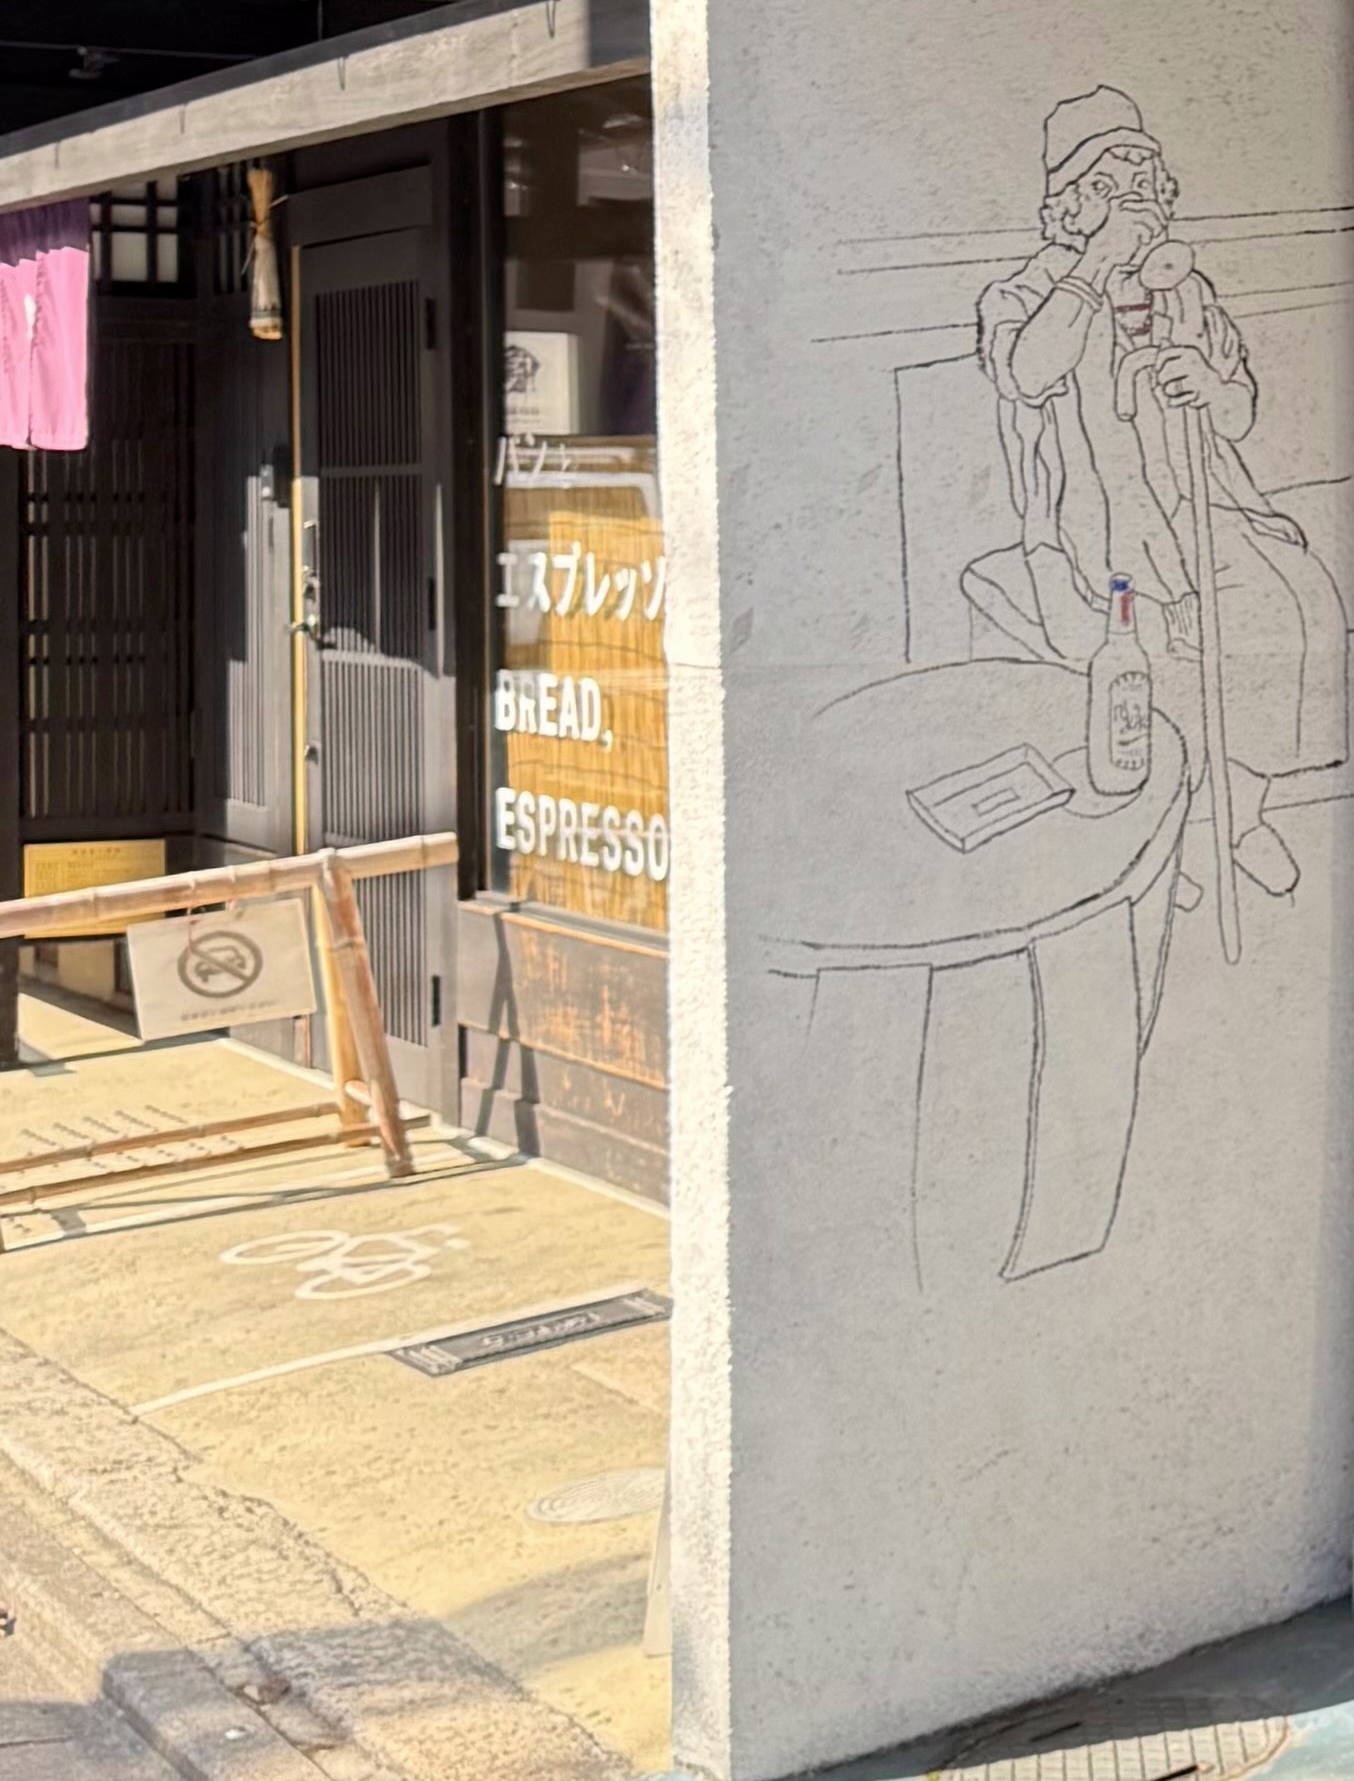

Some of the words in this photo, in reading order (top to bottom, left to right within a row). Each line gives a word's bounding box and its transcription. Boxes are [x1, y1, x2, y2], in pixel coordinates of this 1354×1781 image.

[495, 540, 666, 621] エスプレッソ
[495, 668, 614, 754] BREAD,
[495, 786, 670, 882] ESPRESSO
